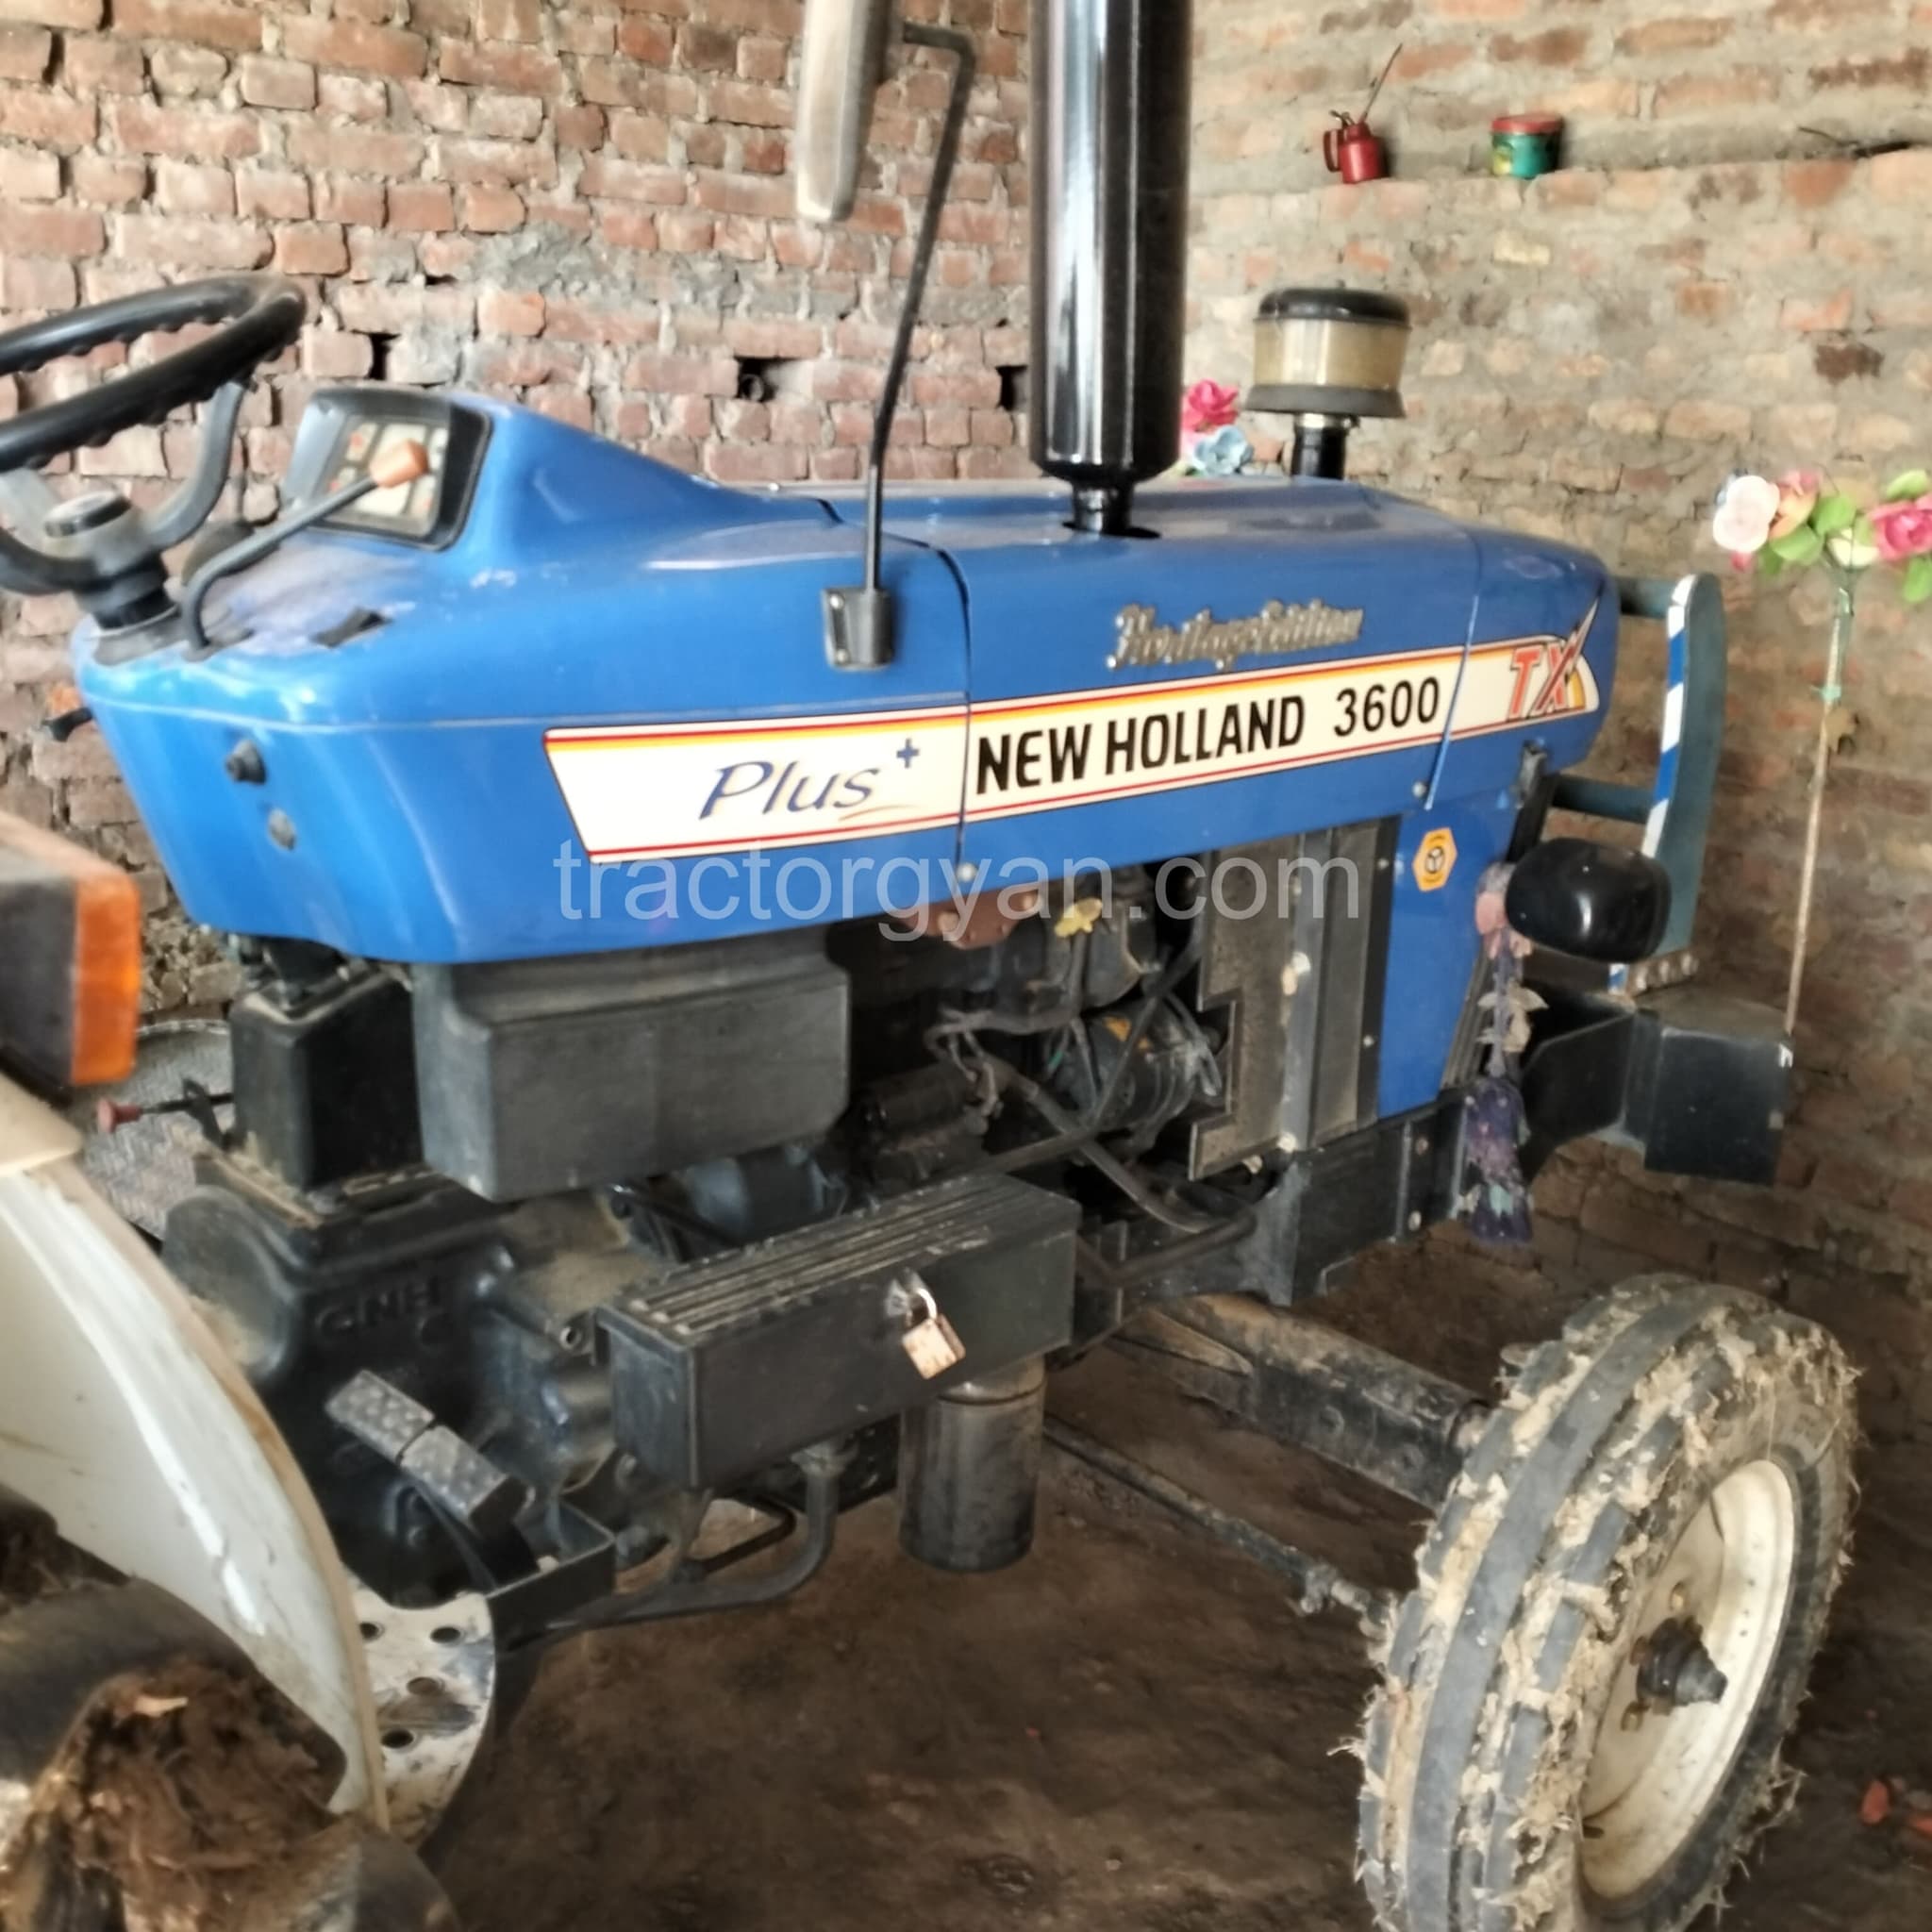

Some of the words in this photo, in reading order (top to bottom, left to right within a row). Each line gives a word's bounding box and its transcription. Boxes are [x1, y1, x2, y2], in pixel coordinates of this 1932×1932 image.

[1507, 604, 1597, 720] TX
[976, 723, 1091, 794] NEW
[1105, 694, 1305, 775] HOLLAND
[1334, 676, 1440, 738] 3600
